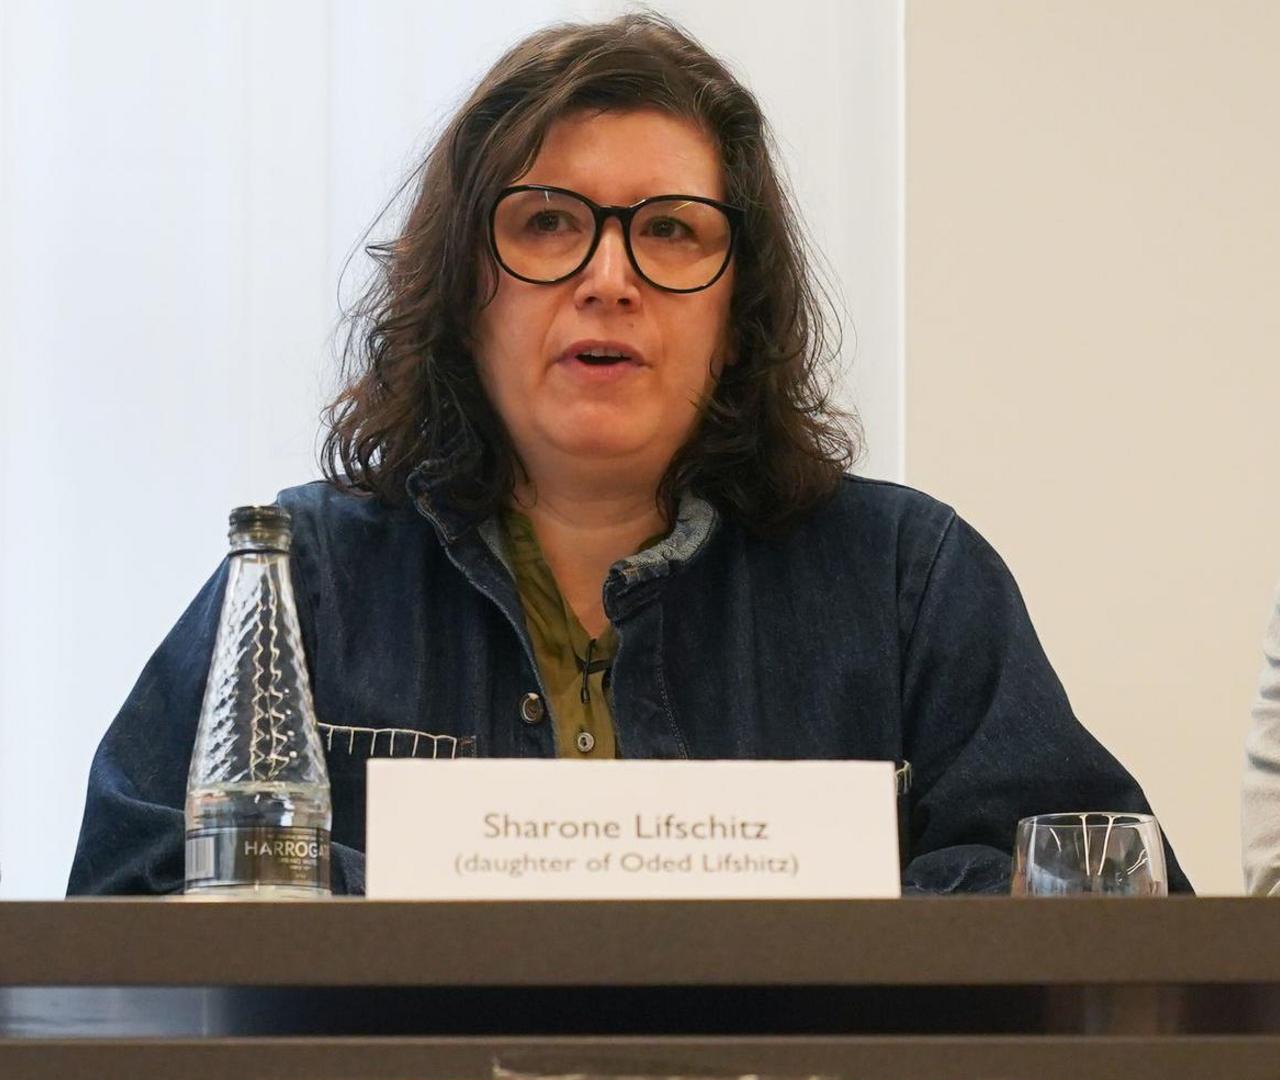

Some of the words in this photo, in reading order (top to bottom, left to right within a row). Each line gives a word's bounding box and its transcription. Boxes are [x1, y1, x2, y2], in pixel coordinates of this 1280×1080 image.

[483, 812, 621, 841] Sharone
[634, 813, 769, 841] Lifschitz
[454, 851, 576, 878] (daughter
[585, 851, 612, 873] of
[620, 851, 693, 873] Oded
[701, 851, 800, 877] Lifshitz)
